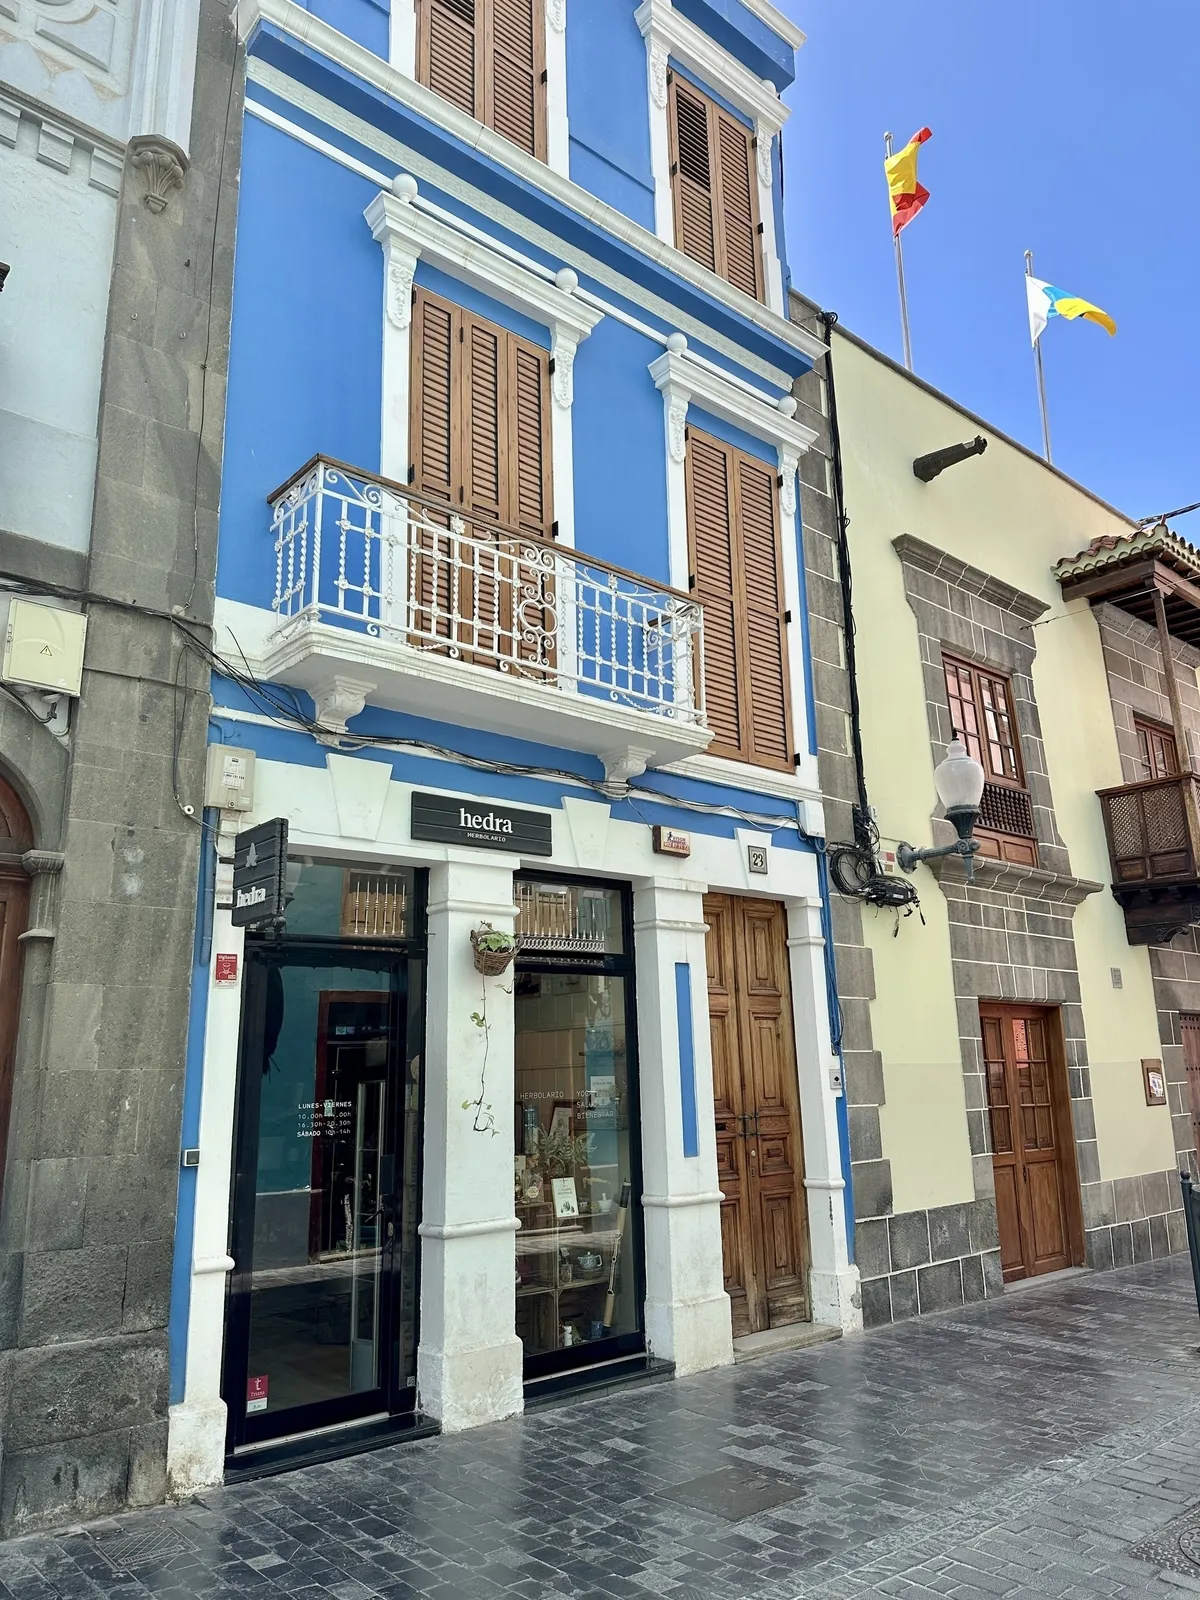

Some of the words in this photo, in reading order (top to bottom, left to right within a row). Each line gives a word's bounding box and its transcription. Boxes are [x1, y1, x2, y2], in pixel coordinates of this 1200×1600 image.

[459, 808, 513, 833] hedra
[467, 832, 506, 842] HERBOLARIO
[752, 852, 764, 868] 23
[236, 886, 266, 908] hedra
[519, 1090, 564, 1100] HERBOLARIO
[298, 1112, 352, 1120] 10.00h.00h
[576, 1110, 614, 1120] BIENESTAR
